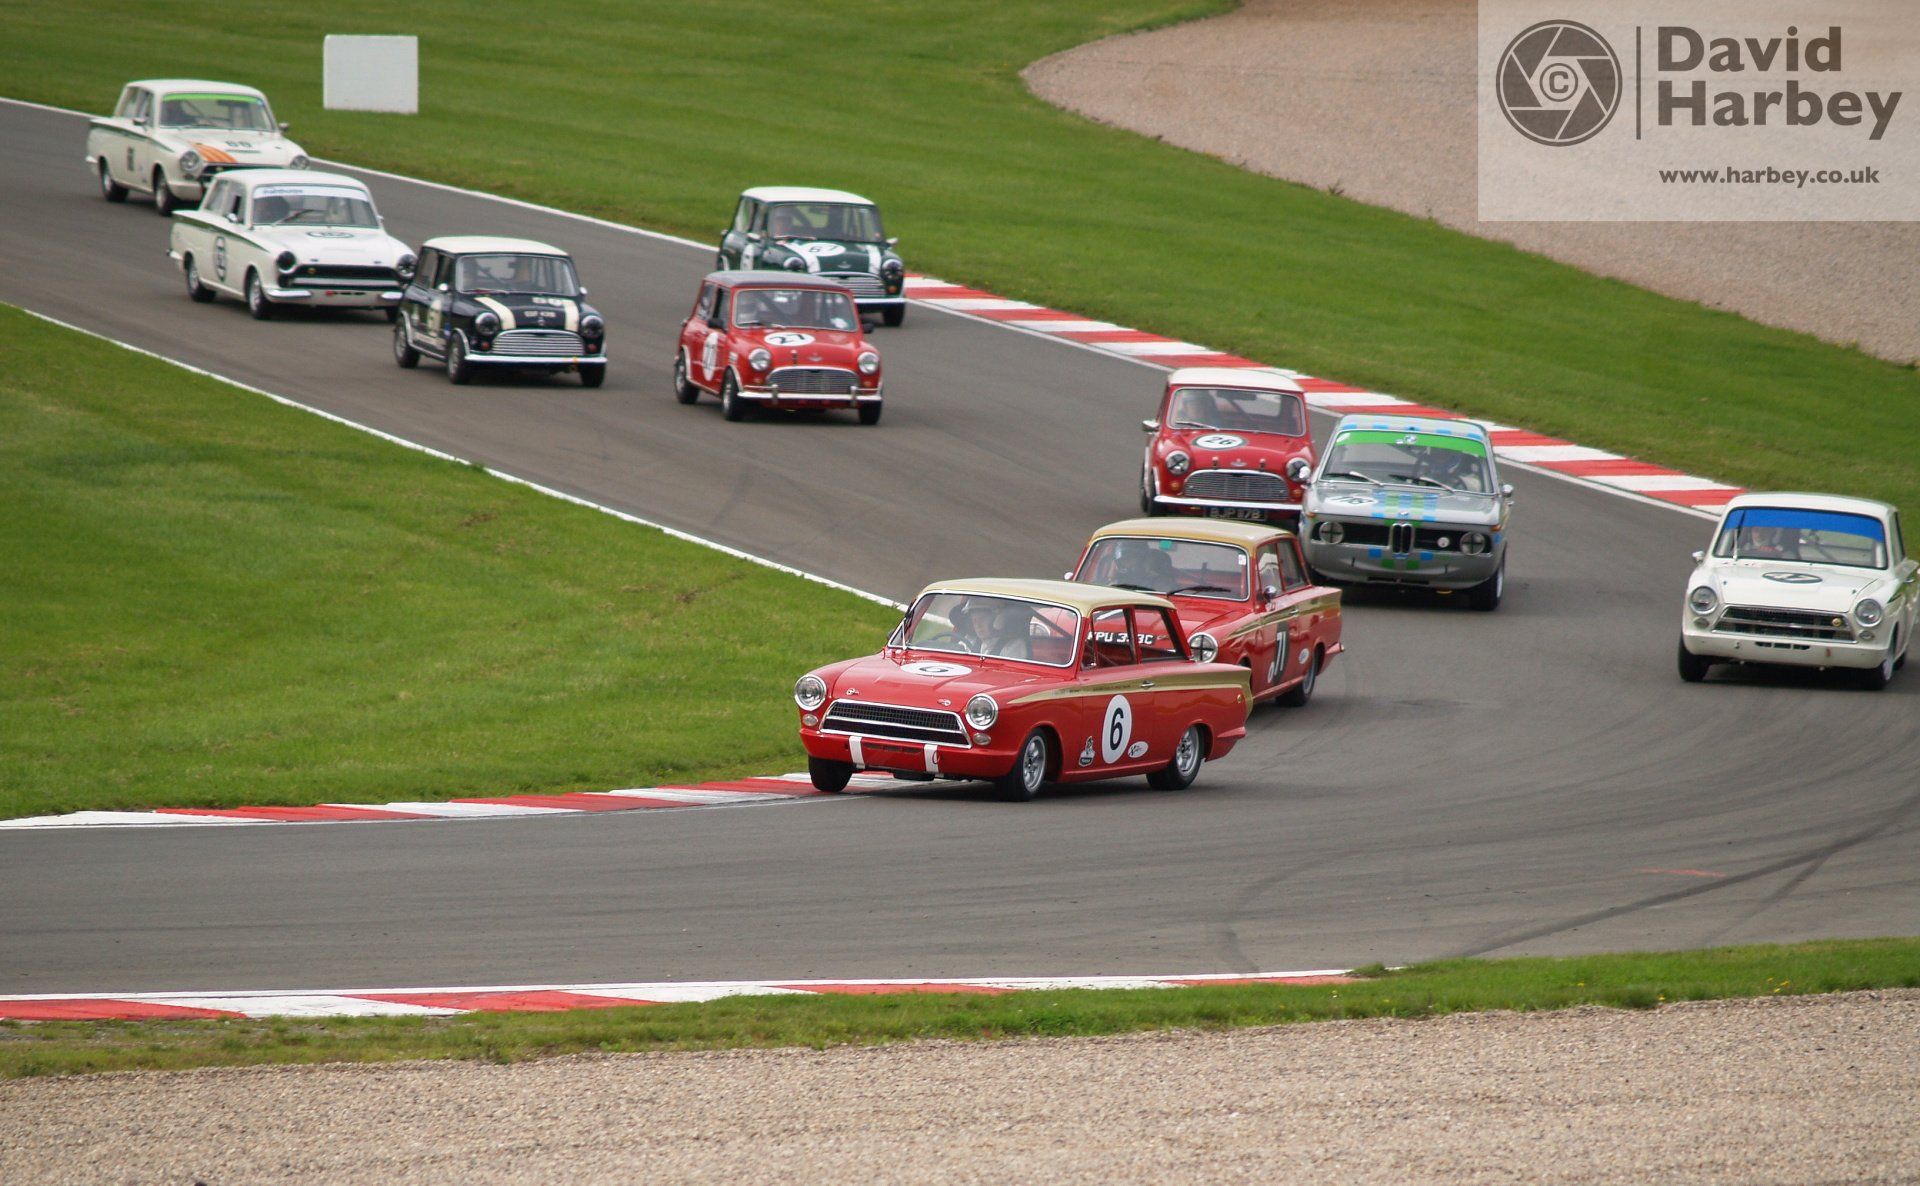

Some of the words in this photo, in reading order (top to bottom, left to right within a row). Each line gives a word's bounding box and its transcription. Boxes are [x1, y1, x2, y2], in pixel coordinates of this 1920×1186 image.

[768, 333, 806, 344] 27
[1203, 436, 1238, 446] 26
[1274, 631, 1286, 676] 71
[1109, 706, 1125, 751] 6
